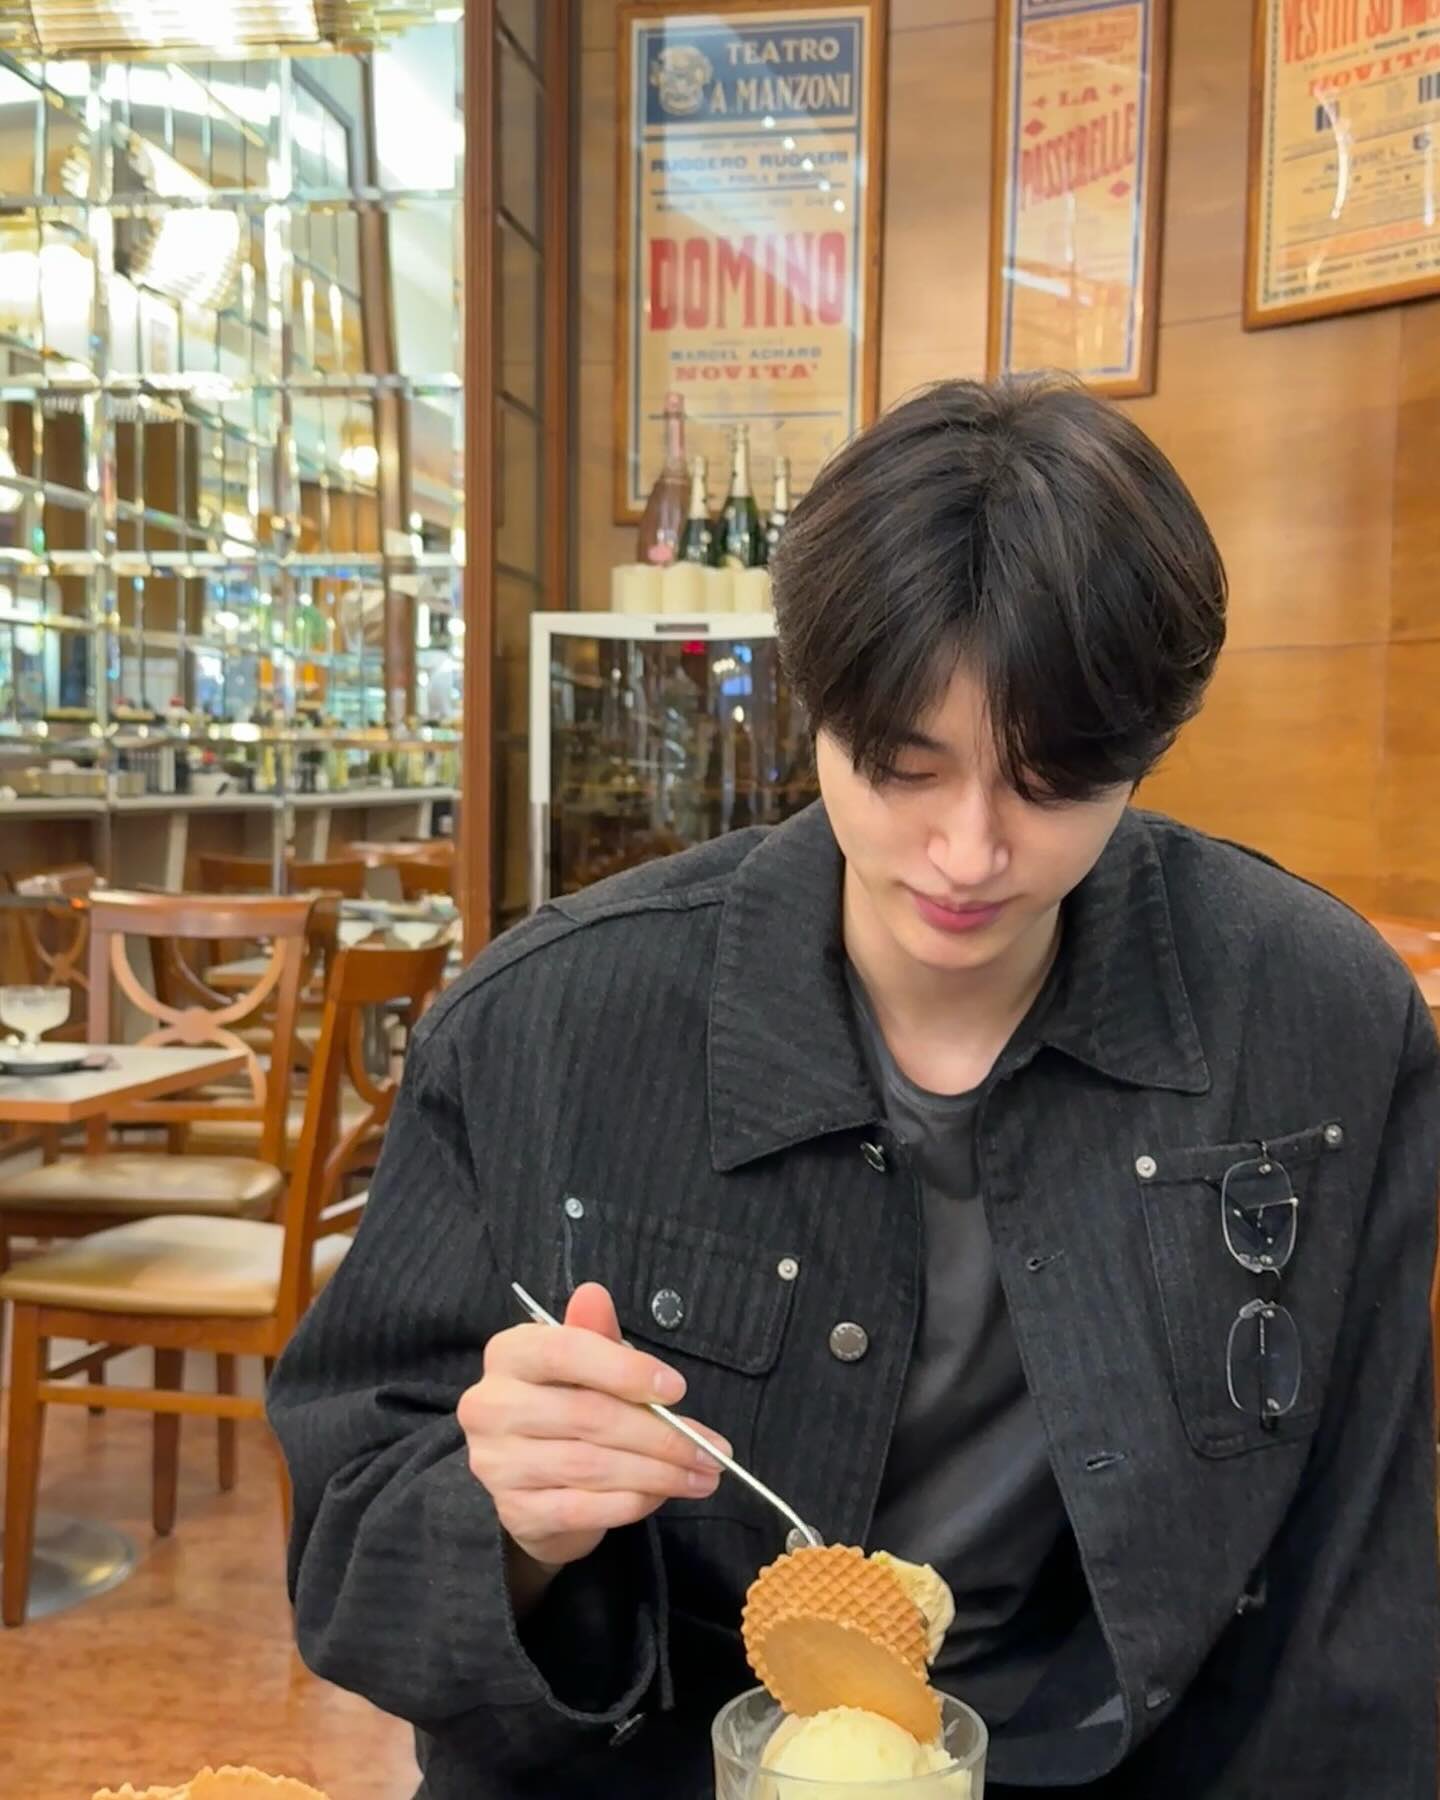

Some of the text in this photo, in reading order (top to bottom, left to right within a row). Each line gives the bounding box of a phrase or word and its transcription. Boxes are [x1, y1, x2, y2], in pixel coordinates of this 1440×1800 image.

[726, 37, 840, 65] TEATRO
[736, 72, 852, 113] MANZONI
[1057, 85, 1100, 106] LA
[648, 231, 847, 331] DOMINO
